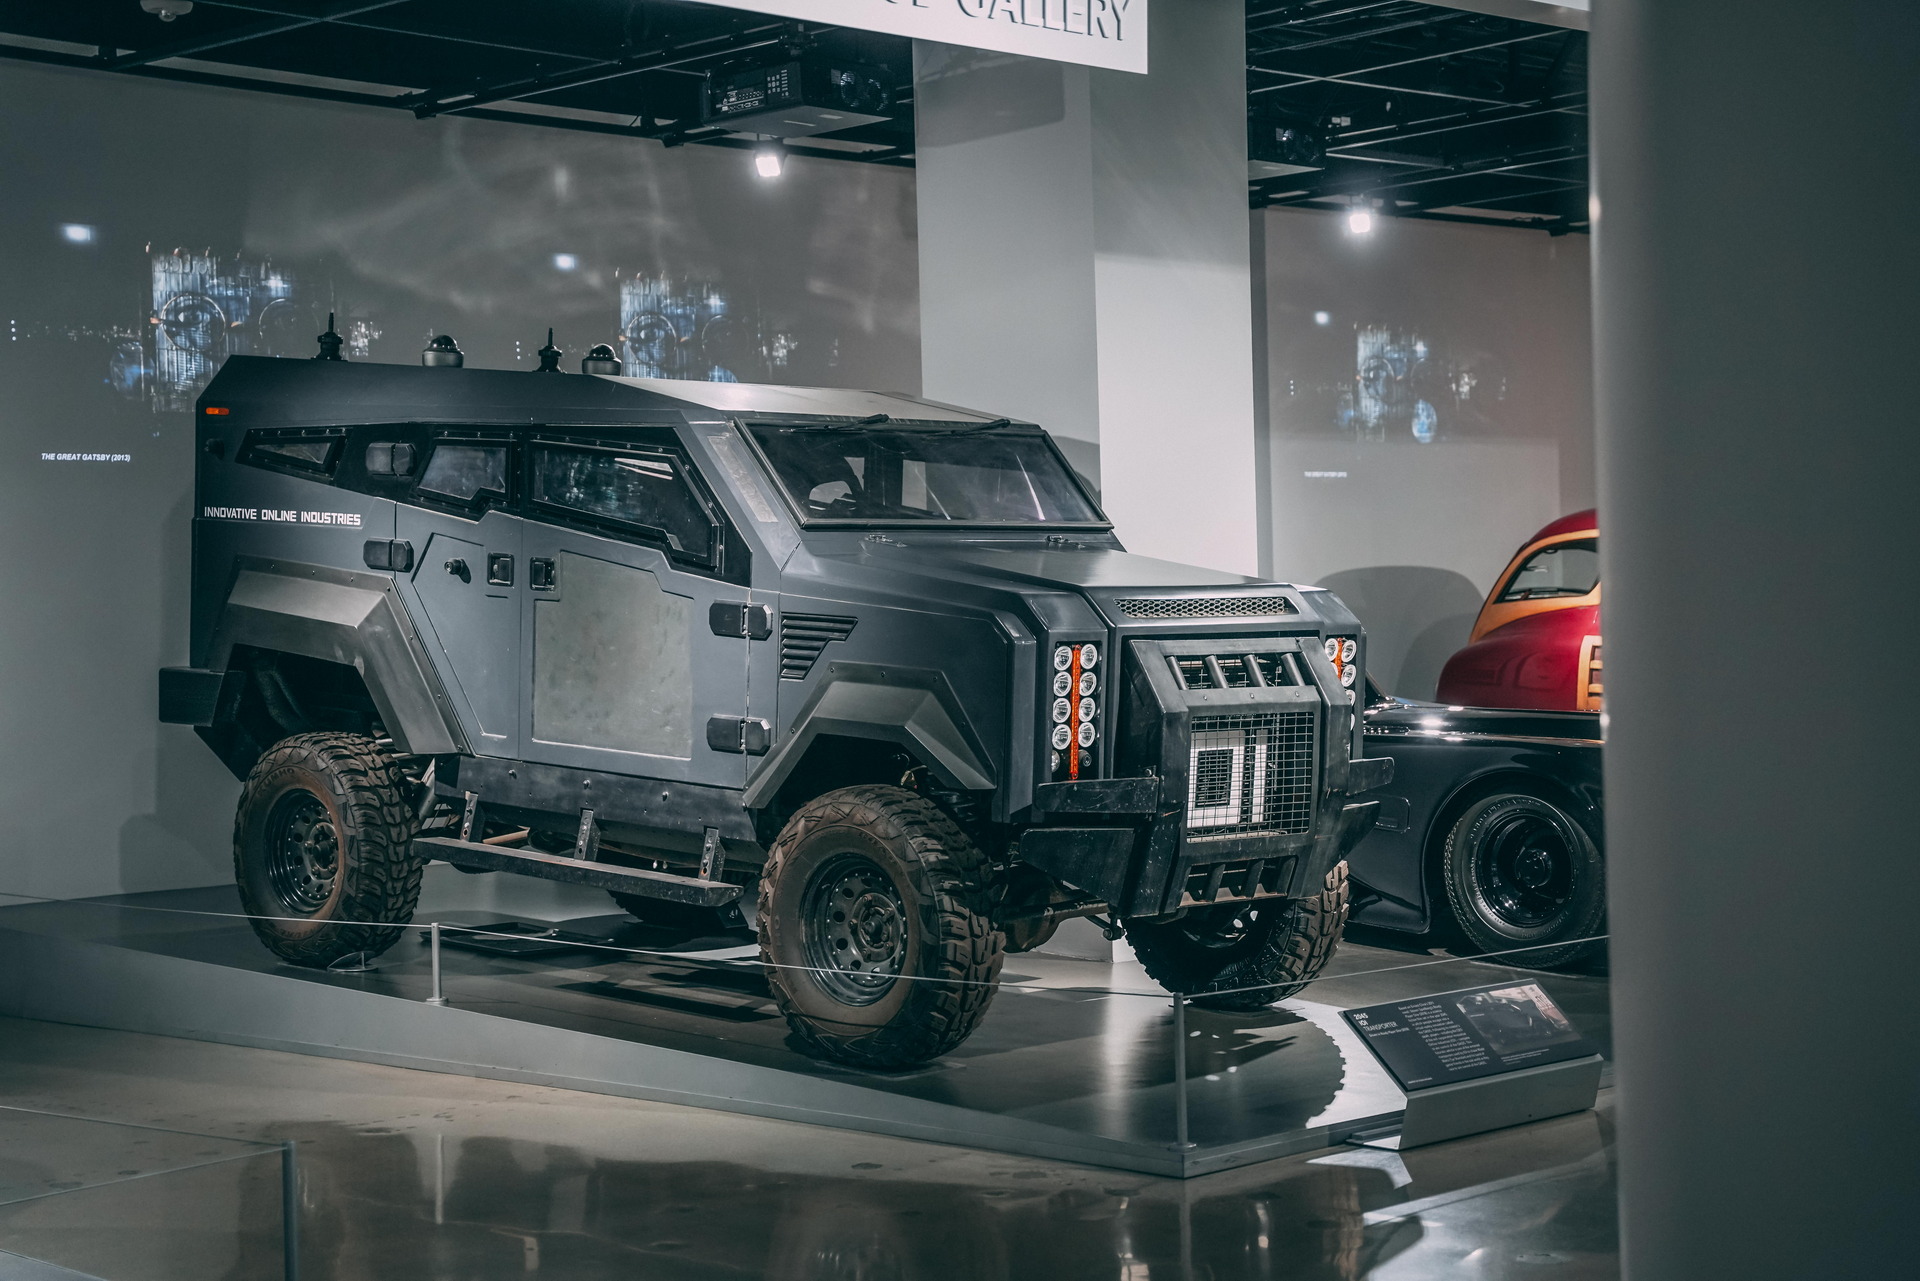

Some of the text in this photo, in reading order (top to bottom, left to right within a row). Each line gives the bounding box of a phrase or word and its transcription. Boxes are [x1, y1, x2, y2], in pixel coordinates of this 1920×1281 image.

[56, 453, 81, 461] GREAT
[82, 453, 110, 461] GATSBY
[111, 454, 131, 462] (2013)
[204, 506, 361, 526] INNOVATIVE ONLINE INDUSTRIES
[1363, 1021, 1398, 1031] TRANSPORTER
